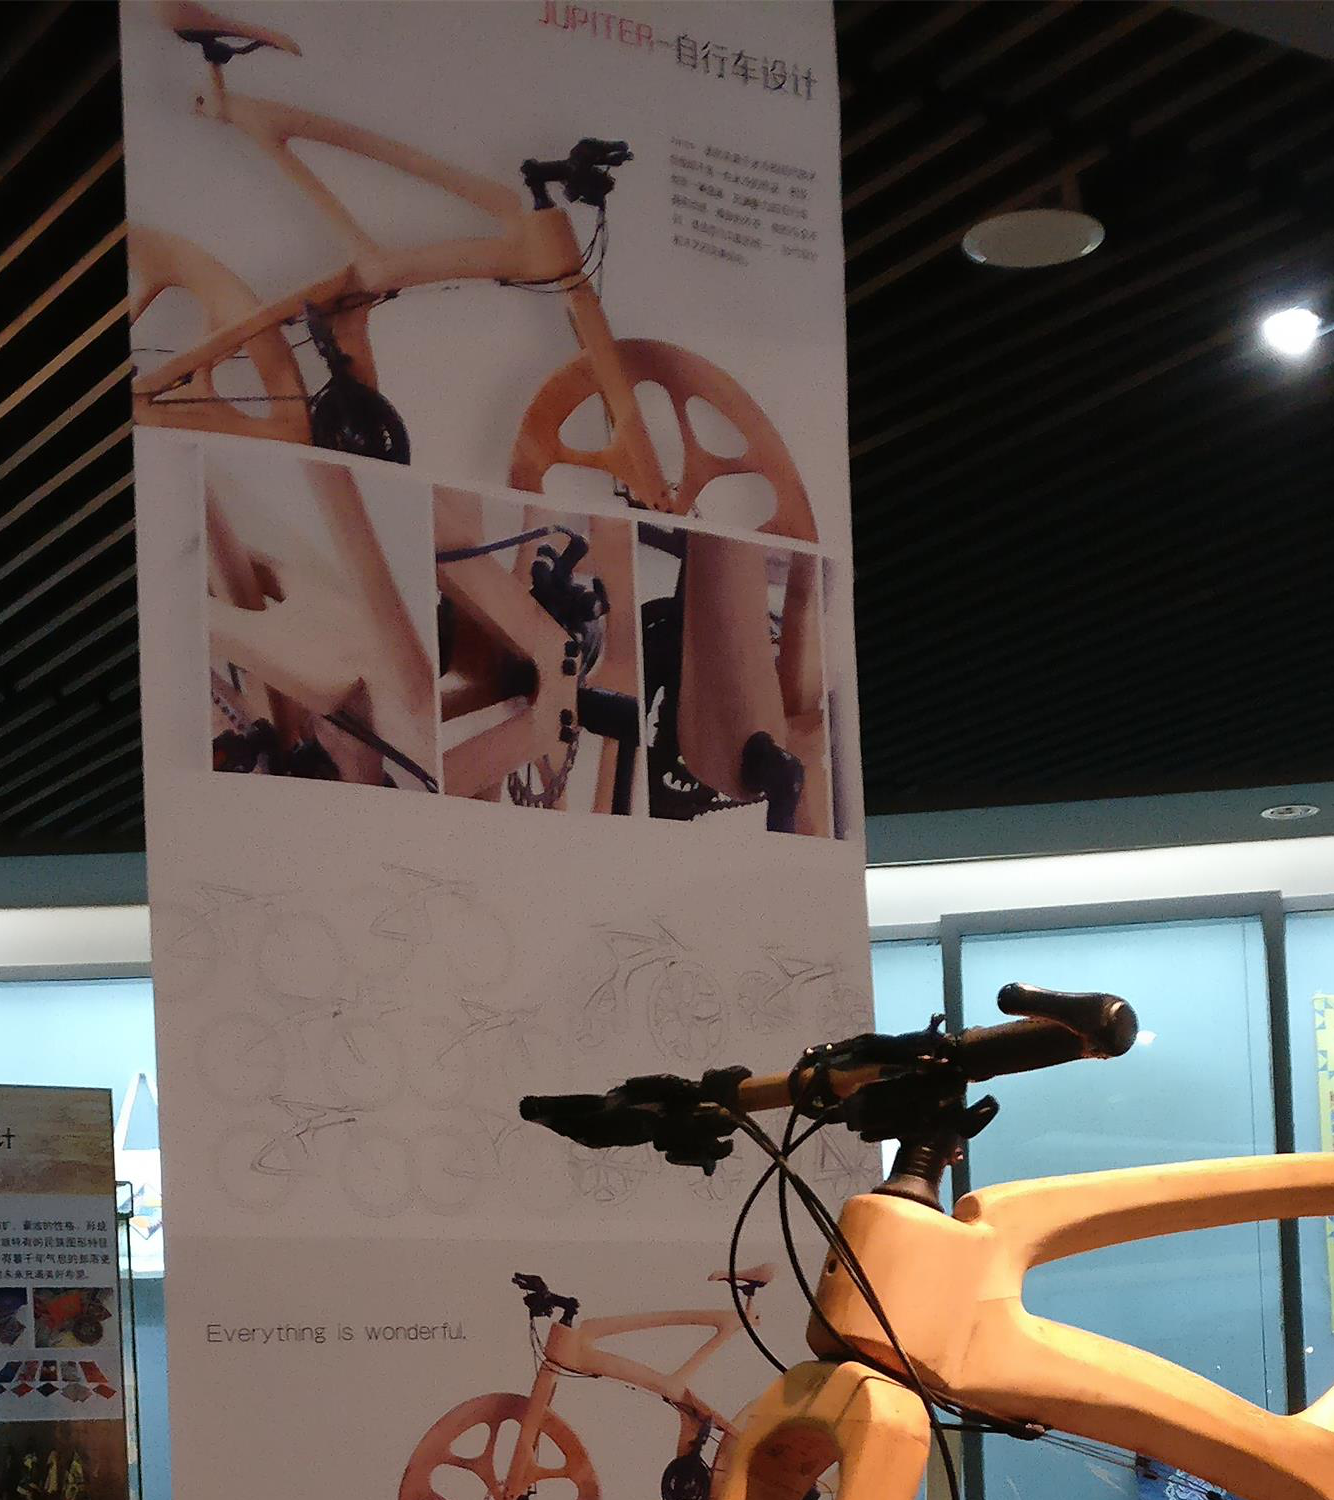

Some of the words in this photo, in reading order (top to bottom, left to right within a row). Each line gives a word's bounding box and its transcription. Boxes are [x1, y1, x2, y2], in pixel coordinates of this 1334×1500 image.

[206, 1323, 326, 1344] Everything
[338, 1323, 355, 1341] is
[365, 1321, 468, 1342] wonderful.
